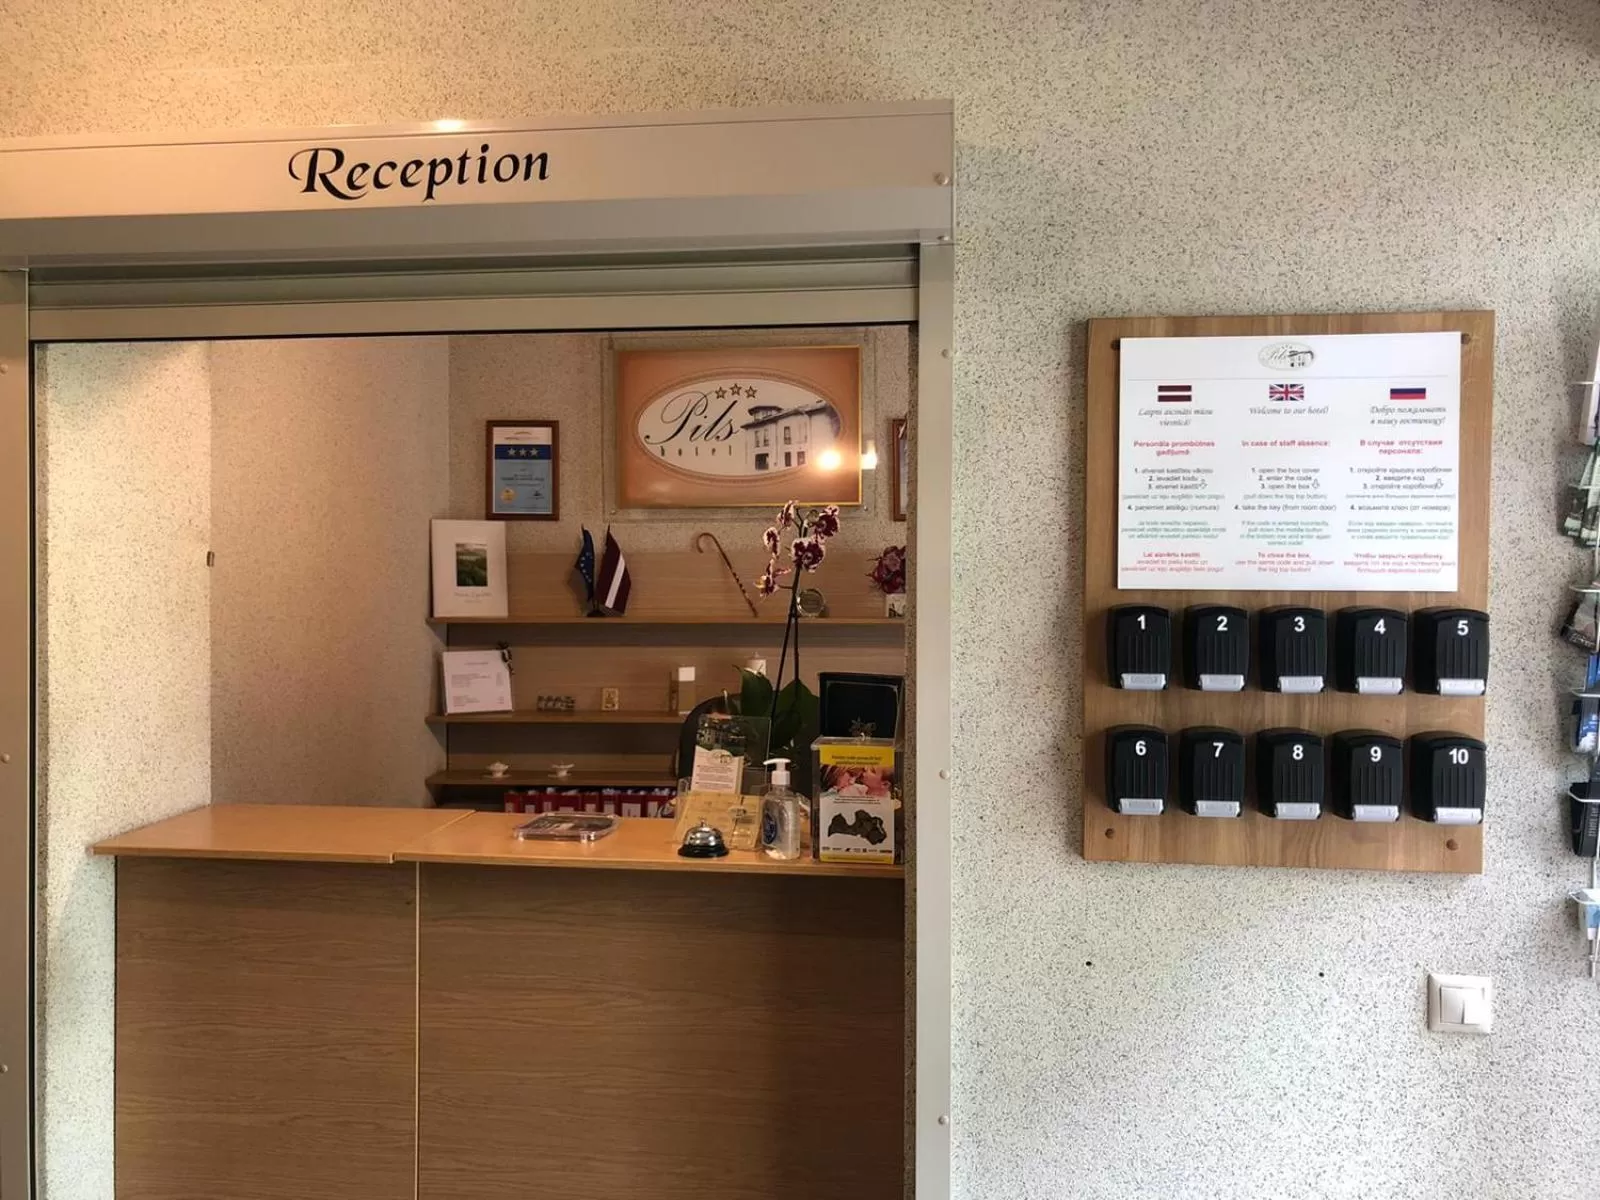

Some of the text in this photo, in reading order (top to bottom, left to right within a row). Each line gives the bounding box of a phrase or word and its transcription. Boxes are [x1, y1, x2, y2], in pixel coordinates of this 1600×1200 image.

[288, 143, 550, 202] Reception
[644, 390, 740, 445] Pils
[1249, 406, 1281, 415] Welcome
[1284, 406, 1292, 415] to
[1293, 406, 1306, 415] our
[660, 445, 732, 458] hotel
[1136, 615, 1147, 631] 1
[1217, 616, 1228, 631] 2
[1294, 616, 1306, 632] 3
[1374, 619, 1386, 635] 4
[1457, 620, 1469, 636] 5
[1135, 741, 1147, 756] 6
[1213, 743, 1224, 758] 7
[1292, 745, 1304, 760] 8
[1370, 747, 1382, 762] 9
[1449, 749, 1469, 765] 10
